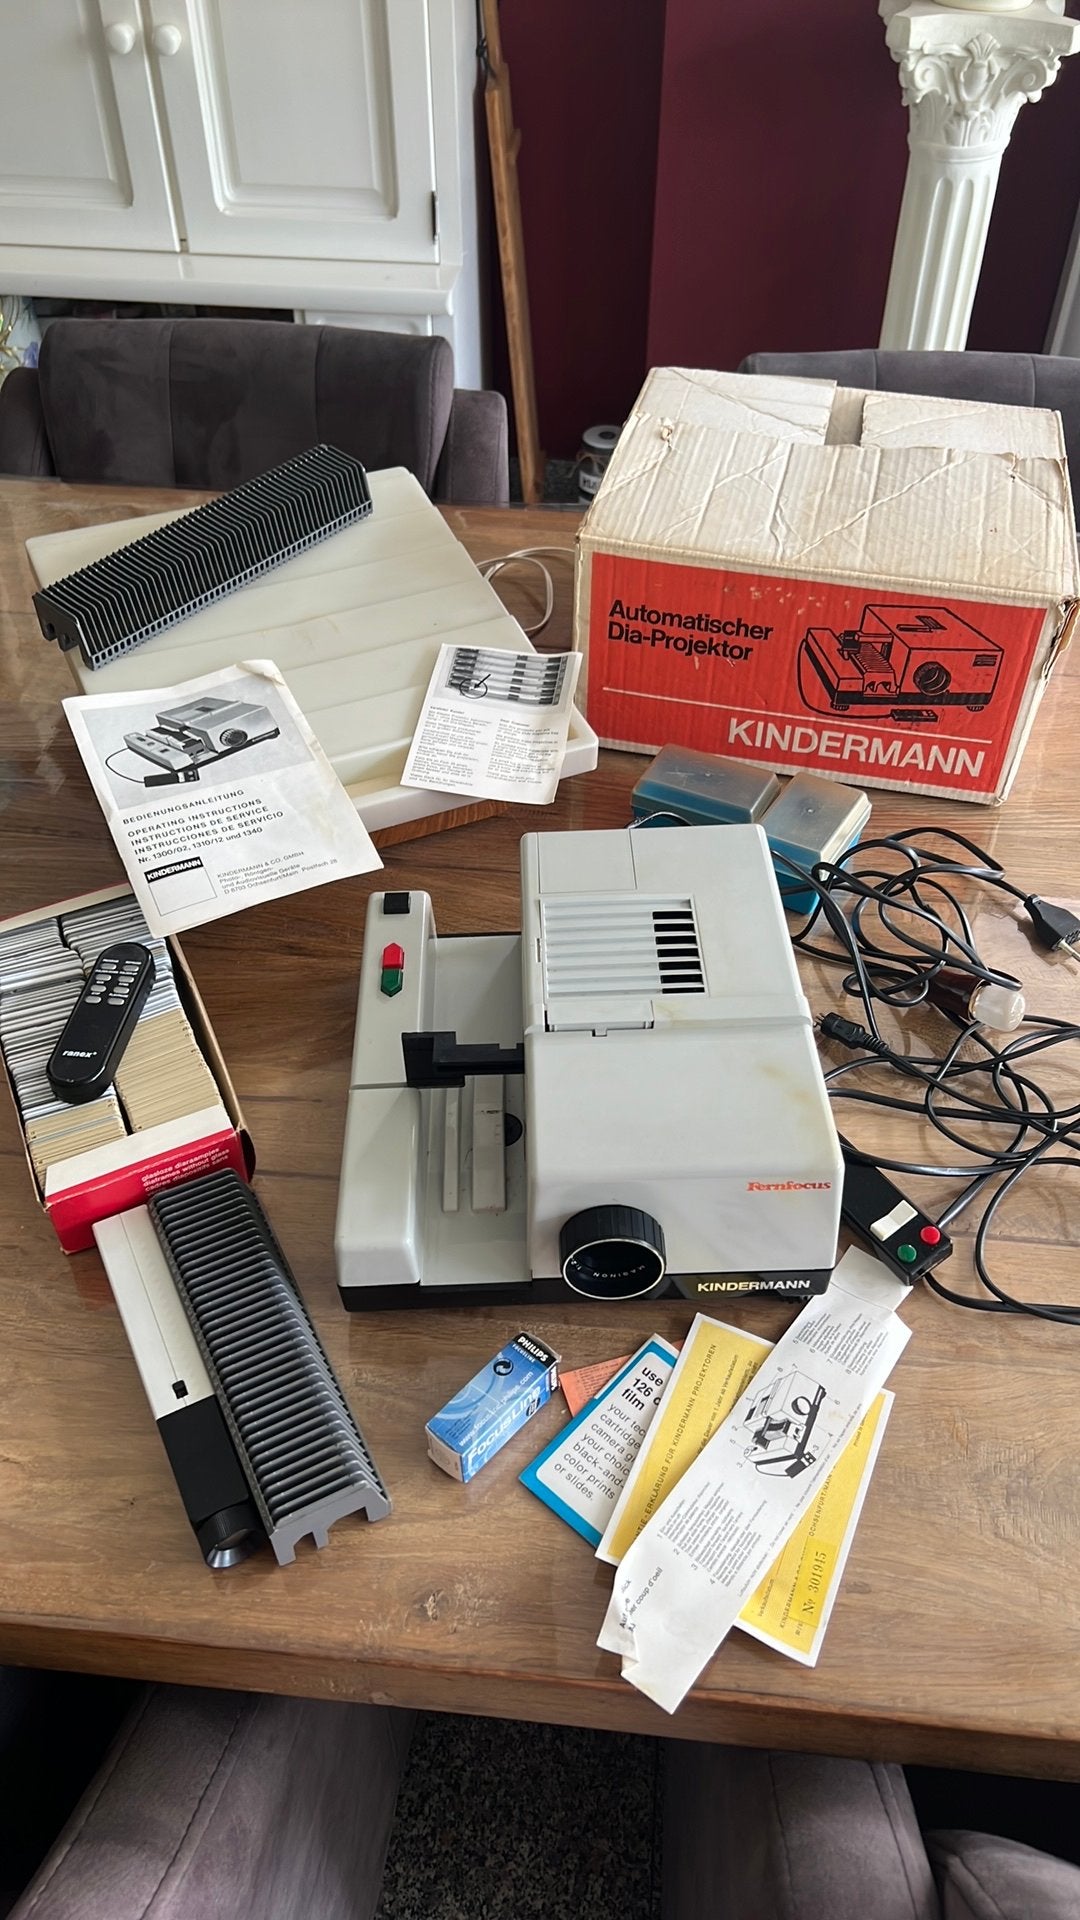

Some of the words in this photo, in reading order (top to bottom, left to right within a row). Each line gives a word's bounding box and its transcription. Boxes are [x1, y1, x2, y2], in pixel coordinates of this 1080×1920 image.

[608, 598, 774, 642] Automatischer
[607, 620, 754, 662] Dia-Projektor
[727, 716, 986, 779] KINDERMANN
[123, 789, 244, 825] BEDIENUNGSANLEITUNG
[128, 818, 185, 838] OPERATING
[188, 798, 262, 821] INSTRUCTIONS
[131, 822, 207, 846] INSTRUCTIONS
[209, 818, 223, 826] DE
[226, 806, 269, 822] SERVICE
[134, 829, 218, 855] INSTRUCCIONES
[221, 825, 235, 833] DE
[237, 811, 284, 829] SERVICIO
[226, 833, 241, 841] und
[243, 826, 263, 837] 1340
[146, 858, 201, 881] KINDERMANN
[141, 1166, 173, 1182] glasloze
[143, 1170, 180, 1187] diaframes
[182, 1158, 209, 1172] without
[210, 1149, 230, 1161] glass
[747, 1180, 832, 1192] Fernfocus
[697, 1279, 811, 1293] KINDERMANN
[517, 1335, 549, 1362] PHILIPS
[632, 1377, 653, 1397] 126
[641, 1367, 664, 1387] use
[608, 1403, 631, 1422] your
[621, 1388, 645, 1411] film
[672, 1398, 696, 1448] KINDERMANN
[691, 1343, 717, 1397] PROJEKTOREN
[581, 1433, 605, 1453] your
[591, 1423, 625, 1455] camera
[600, 1413, 641, 1450] cartridge
[554, 1463, 566, 1473] or
[565, 1472, 594, 1501] slides.
[563, 1453, 589, 1476] color
[587, 1473, 616, 1500] prints
[808, 1551, 827, 1593] 301945
[636, 1587, 650, 1604] coup
